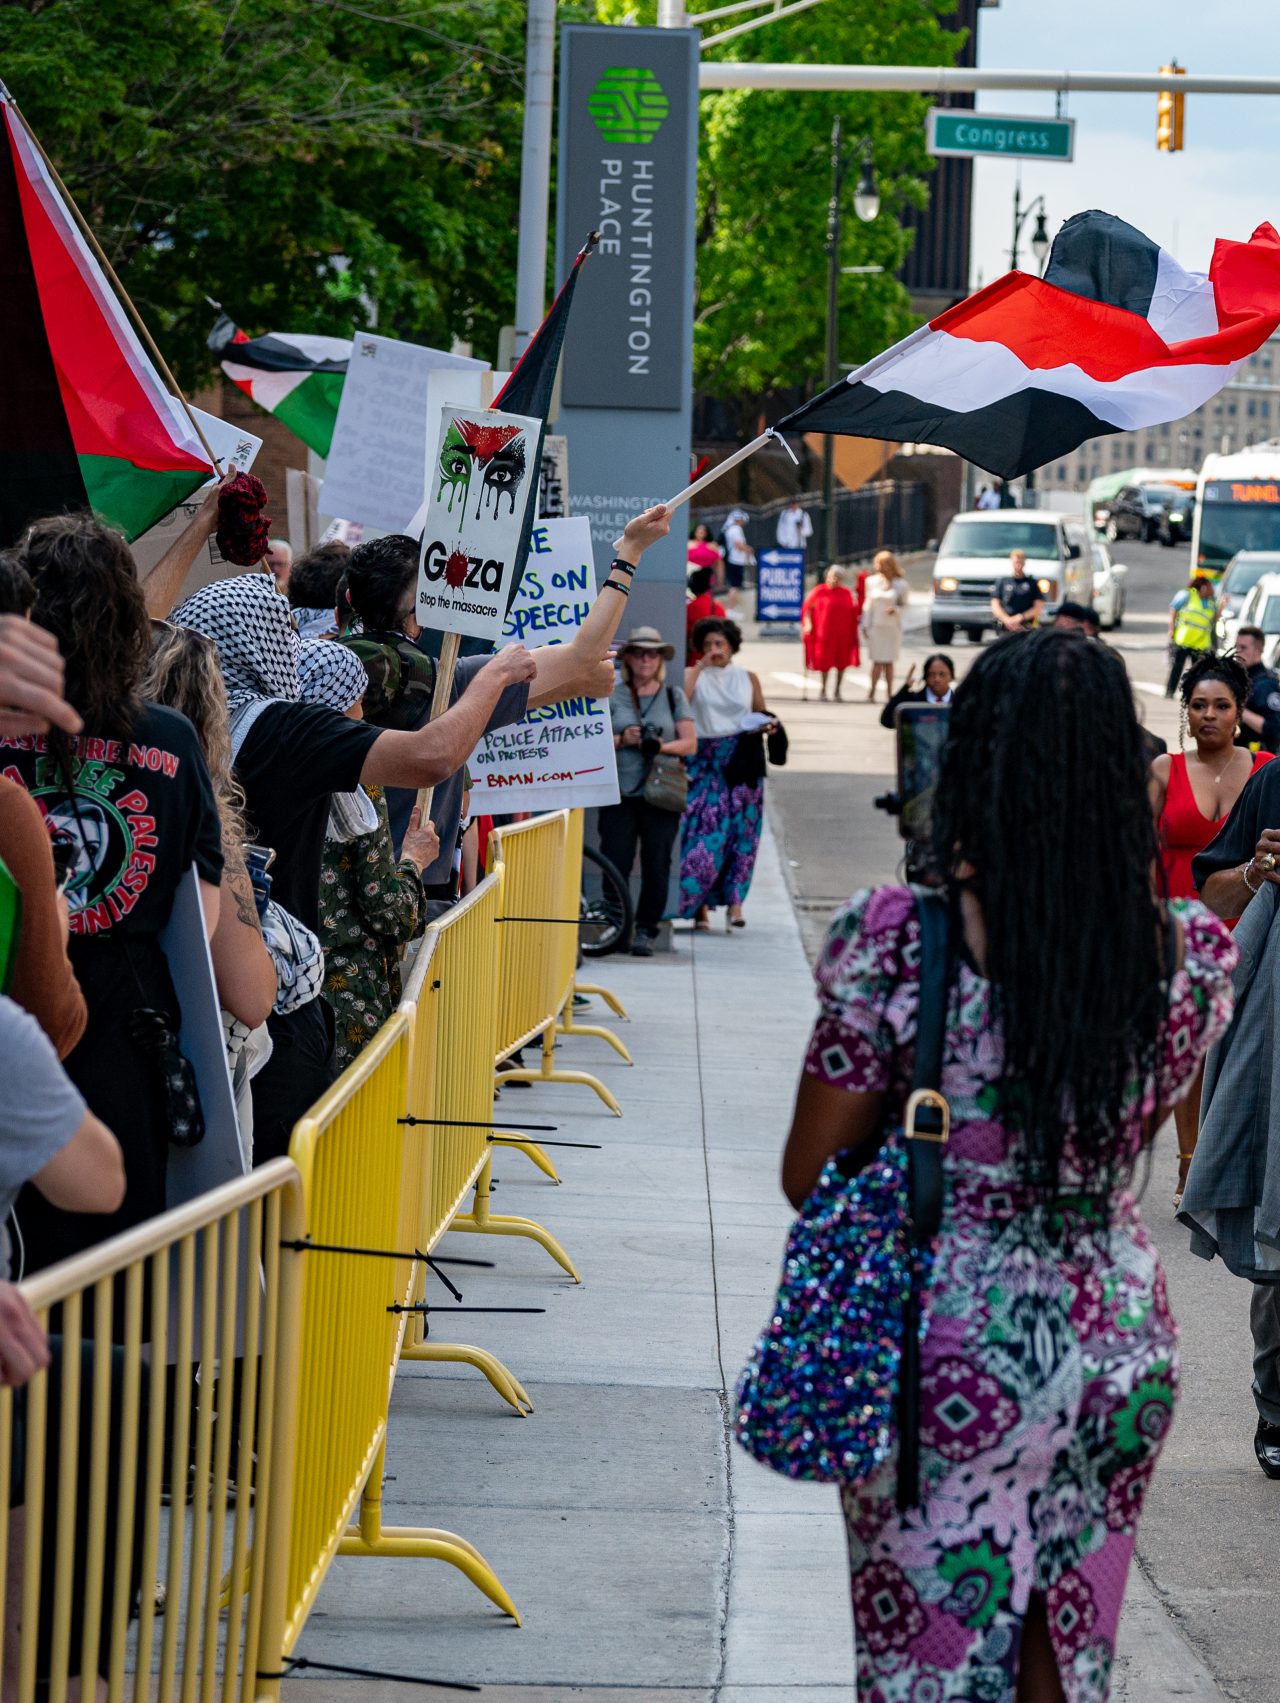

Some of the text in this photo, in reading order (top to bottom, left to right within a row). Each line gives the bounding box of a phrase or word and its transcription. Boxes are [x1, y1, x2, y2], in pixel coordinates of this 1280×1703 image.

[955, 123, 1050, 151] Congress
[599, 159, 623, 256] PLACE
[627, 160, 654, 376] HUNTINGTON
[1231, 483, 1280, 503] TUNNEL
[424, 541, 504, 593] Gza
[552, 564, 588, 591] ON
[760, 567, 802, 586] PUBLIC
[420, 591, 498, 618] Stop the massacre
[760, 586, 802, 602] PARKING
[501, 601, 590, 640] SPEECH
[484, 722, 604, 750] POLICE ATTACKS
[128, 743, 180, 779] NOW
[476, 746, 549, 764] ON PROTESTS
[35, 756, 159, 935] FREE PALESTINE
